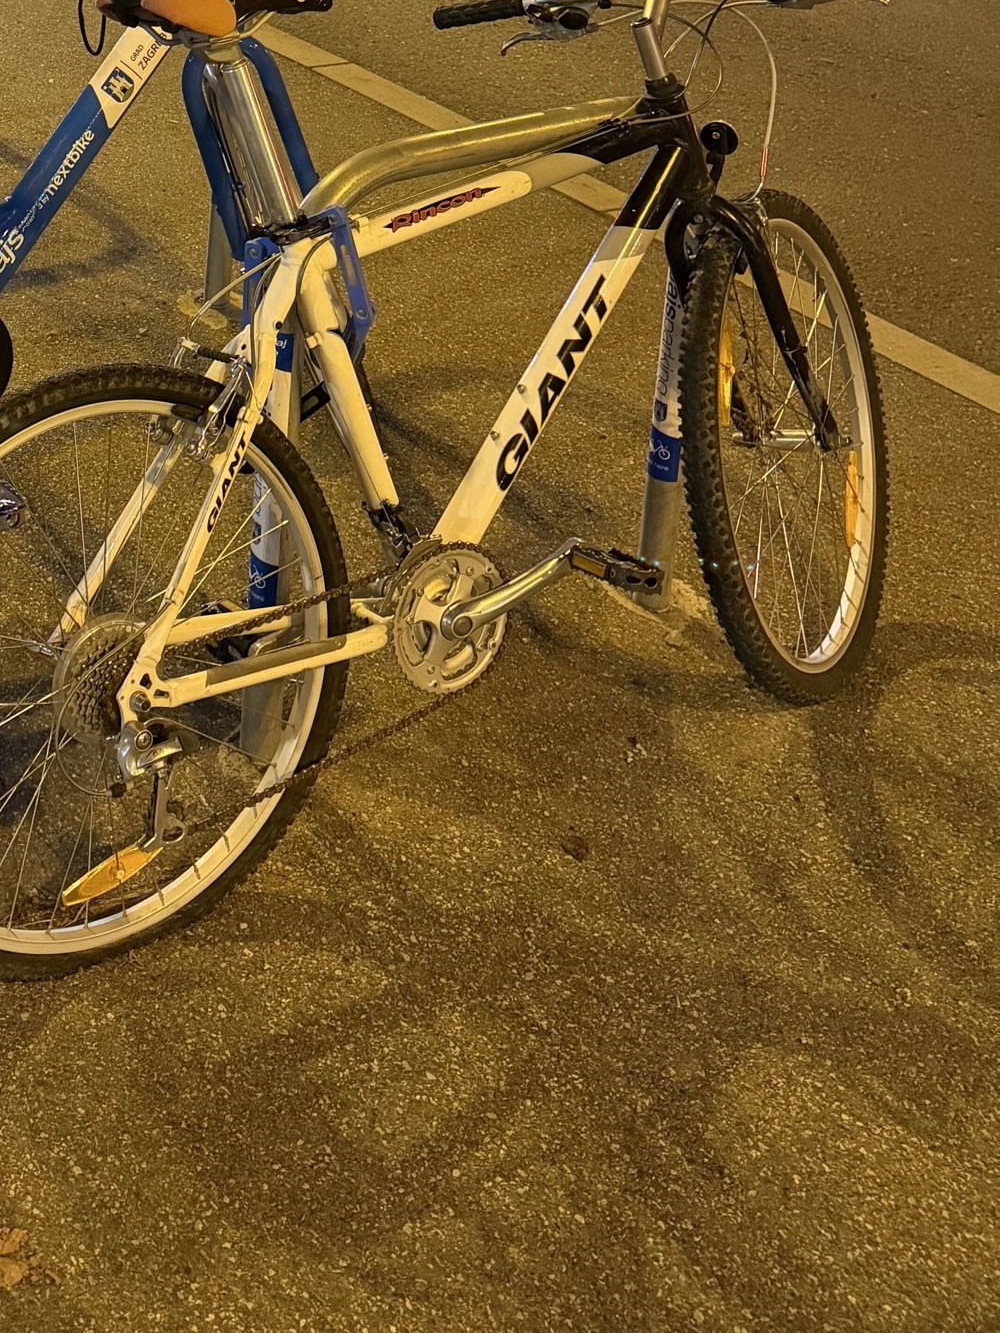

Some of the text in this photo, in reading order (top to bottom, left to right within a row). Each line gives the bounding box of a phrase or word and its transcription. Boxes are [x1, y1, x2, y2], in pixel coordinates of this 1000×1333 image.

[130, 44, 144, 62] GRAD
[45, 129, 95, 197] nextbike
[391, 187, 483, 233] Rincon
[496, 273, 608, 492] GIANT
[207, 430, 248, 534] GIANT
